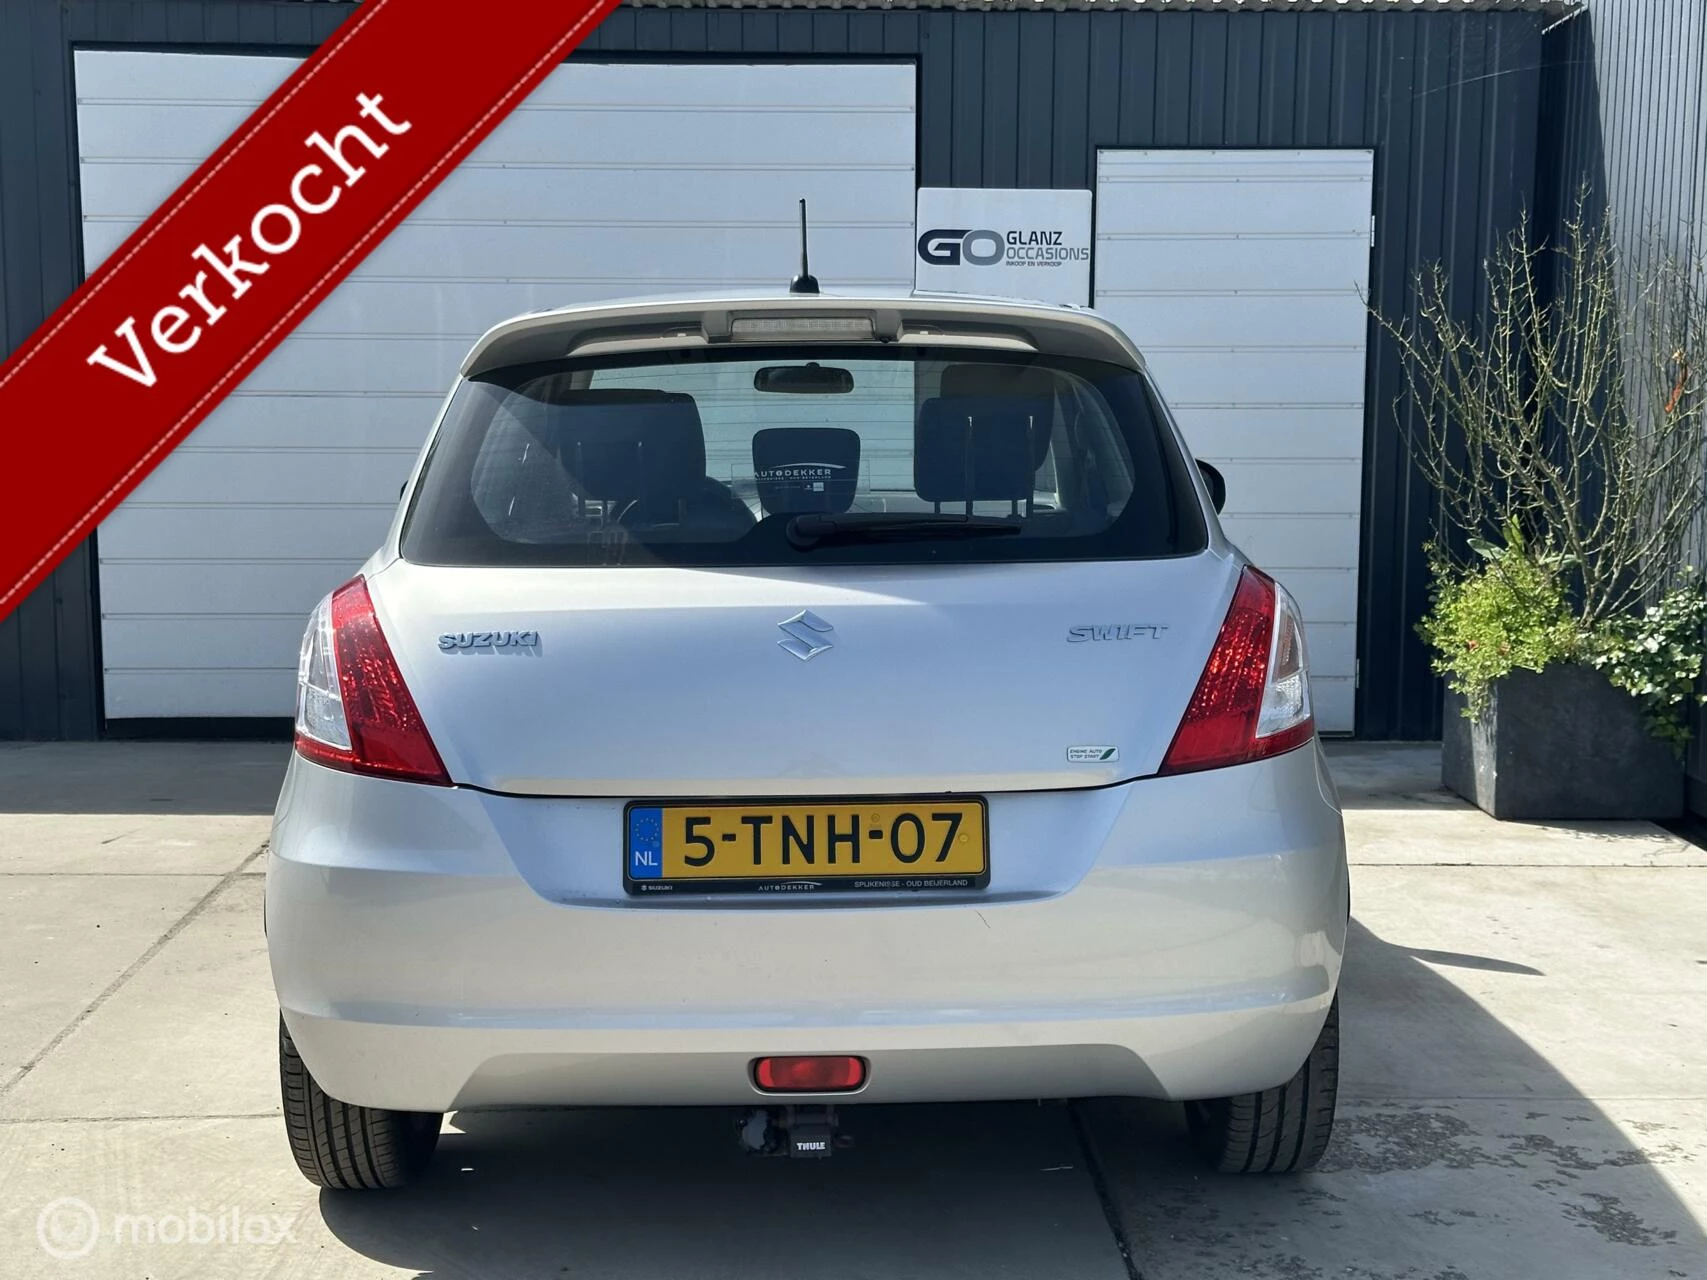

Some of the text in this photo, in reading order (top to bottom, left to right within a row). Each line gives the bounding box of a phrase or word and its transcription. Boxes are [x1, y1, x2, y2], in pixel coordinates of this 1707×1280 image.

[1006, 231, 1063, 245] GLANZ
[918, 229, 1005, 266] GO
[1006, 247, 1089, 261] OCCASIONS
[438, 629, 539, 650] SUZUKI
[1067, 624, 1169, 643] SWIFT
[684, 812, 963, 867] 5-TNH-07
[635, 851, 658, 866] NL
[758, 884, 815, 892] AUTODEKKER
[924, 879, 968, 887] BEIJERLAND
[796, 1142, 826, 1151] THULE
